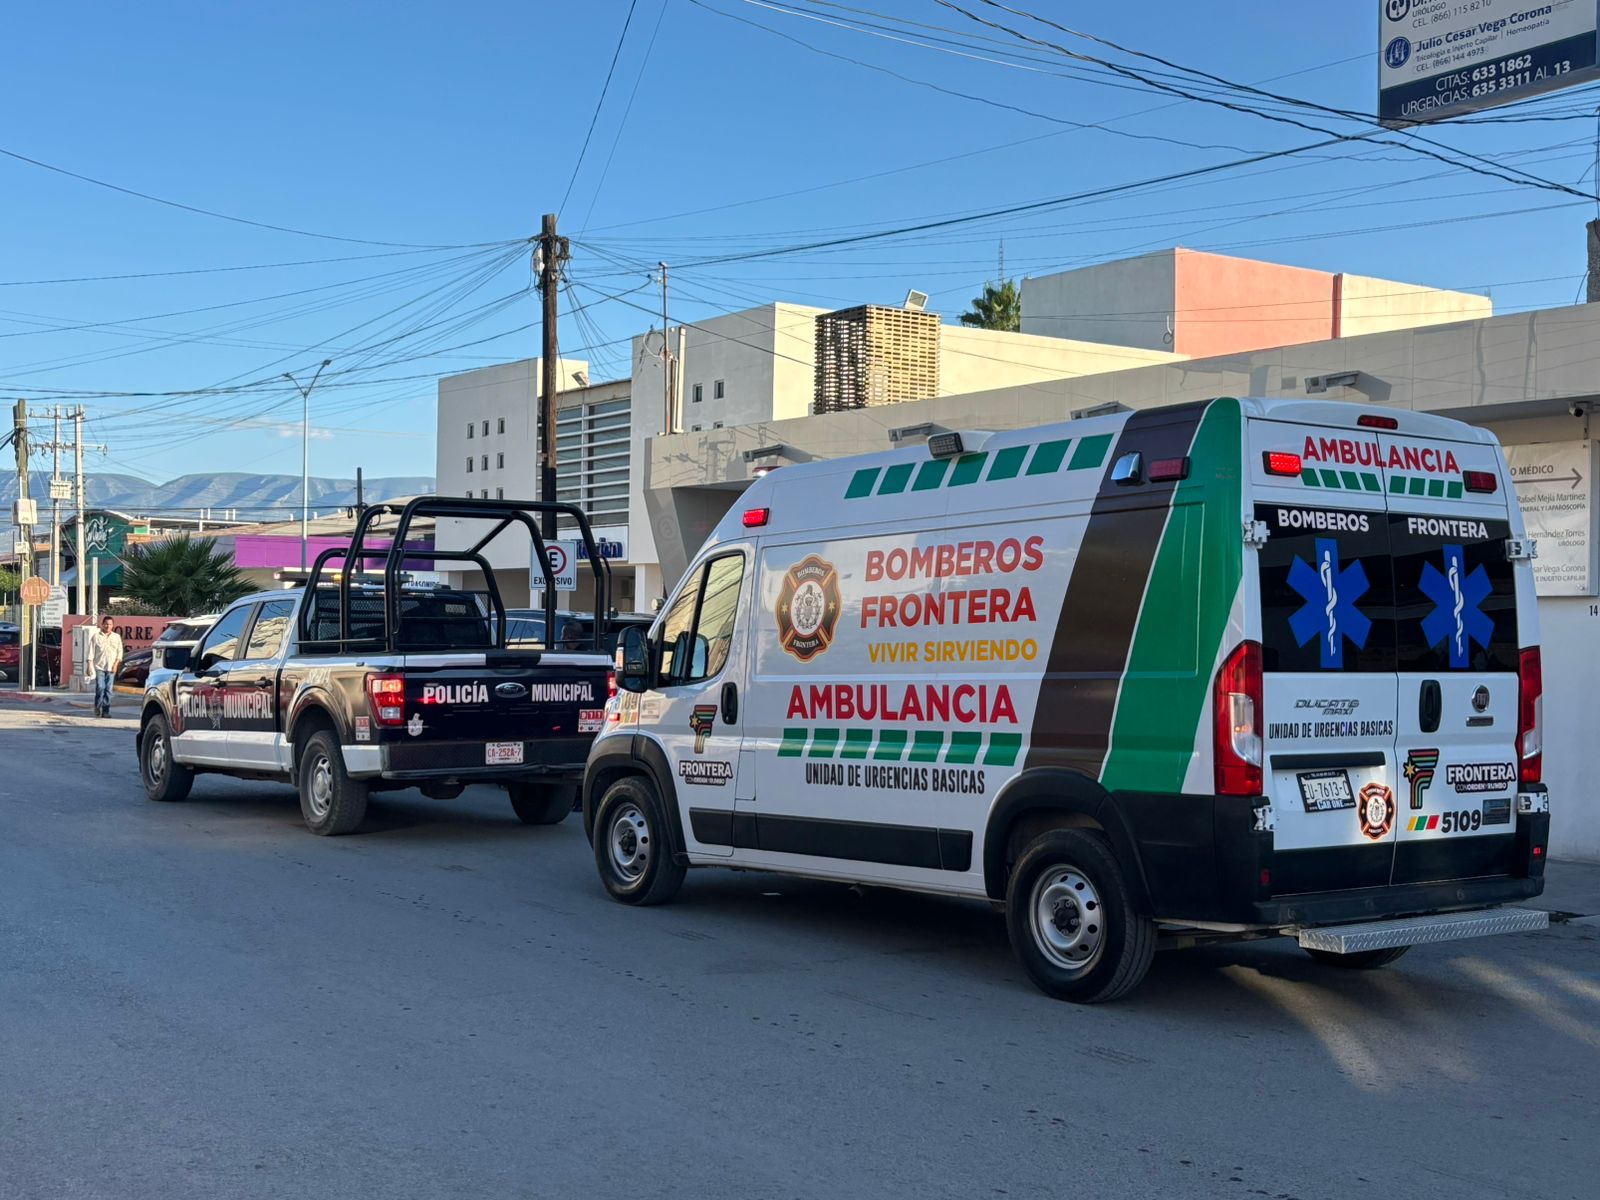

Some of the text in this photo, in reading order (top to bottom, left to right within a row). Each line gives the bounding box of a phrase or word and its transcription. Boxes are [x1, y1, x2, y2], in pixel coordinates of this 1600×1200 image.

[1454, 5, 1468, 16] 115
[1470, 2, 1481, 11] 82
[1416, 5, 1552, 53] Julio Cesar Vega Corona
[1435, 54, 1532, 92] CITAS: 633 1862
[1401, 60, 1571, 116] URGENCIAS: 635 3311 AL 13
[1303, 436, 1460, 474] AMBULANCIA
[1518, 464, 1554, 475] MÉDICO
[1277, 508, 1369, 533] BOMBEROS
[1407, 517, 1489, 539] FRONTERA
[864, 535, 1044, 582] BOMBEROS
[1560, 563, 1586, 573] Corona
[533, 577, 573, 586] EXCSIVO
[797, 566, 825, 578] BOMBEROS
[22, 585, 49, 598] ALTO
[860, 586, 1037, 629] FRONTERA
[1589, 604, 1599, 617] 14
[113, 625, 154, 641] ORRE
[792, 639, 819, 648] FRONTERA
[868, 638, 1038, 663] VIVIR SIRVIENDO
[423, 681, 489, 704] POLICÍA
[531, 683, 594, 702] MUNICIPAL
[223, 694, 274, 719] MUNICIPAL
[786, 684, 1019, 724] AMBULANCIA
[1295, 699, 1361, 709] DUCATO
[1269, 720, 1394, 740] UNIDAD DE URGENCIAS BASICAS
[680, 762, 732, 777] FRONTERA
[806, 762, 985, 795] UNIDAD DE URGENCIAS BASICAS
[1448, 764, 1515, 783] FRONTERA
[1441, 810, 1481, 833] 5109
